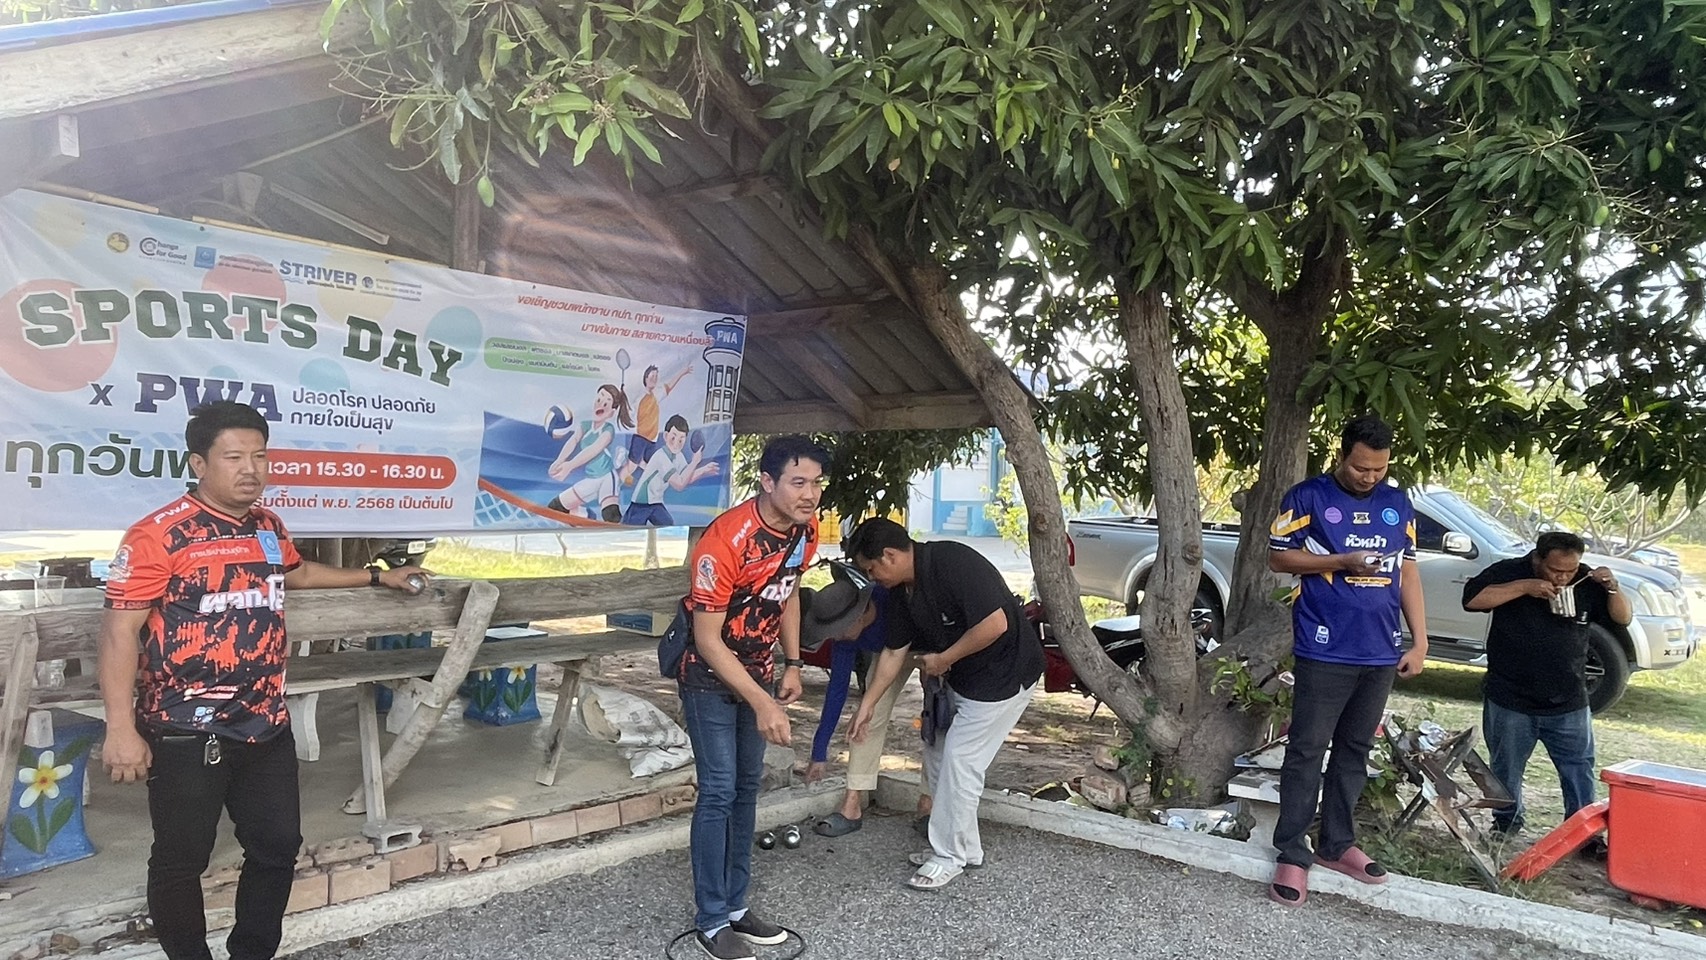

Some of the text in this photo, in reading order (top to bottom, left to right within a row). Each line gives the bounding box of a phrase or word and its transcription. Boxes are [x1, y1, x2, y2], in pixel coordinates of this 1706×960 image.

[168, 251, 187, 260] Good
[279, 259, 357, 286] STRIVER
[518, 294, 610, 317] ขอเชิญชวนพนักงาน
[635, 312, 664, 325] ทุกท่าน
[18, 289, 463, 387] SPORTS DAY
[716, 330, 738, 344] PWA
[134, 372, 283, 421] PWA
[292, 388, 436, 414] ปลอดโรค ปลอดภัย
[290, 409, 394, 435] กายใจเป็นสุข
[5, 433, 199, 489] ทุกวันพุ
[268, 461, 312, 475] เวลา
[316, 462, 366, 477] 15.30
[382, 464, 427, 480] 16.30
[430, 467, 445, 480] น.
[154, 501, 190, 525] PWA
[322, 497, 351, 509] พ.ย.
[355, 497, 395, 509] 2568
[399, 493, 454, 510] เป็นต้นไป
[731, 518, 753, 547] PWA
[1344, 533, 1388, 548] หัวหน้า
